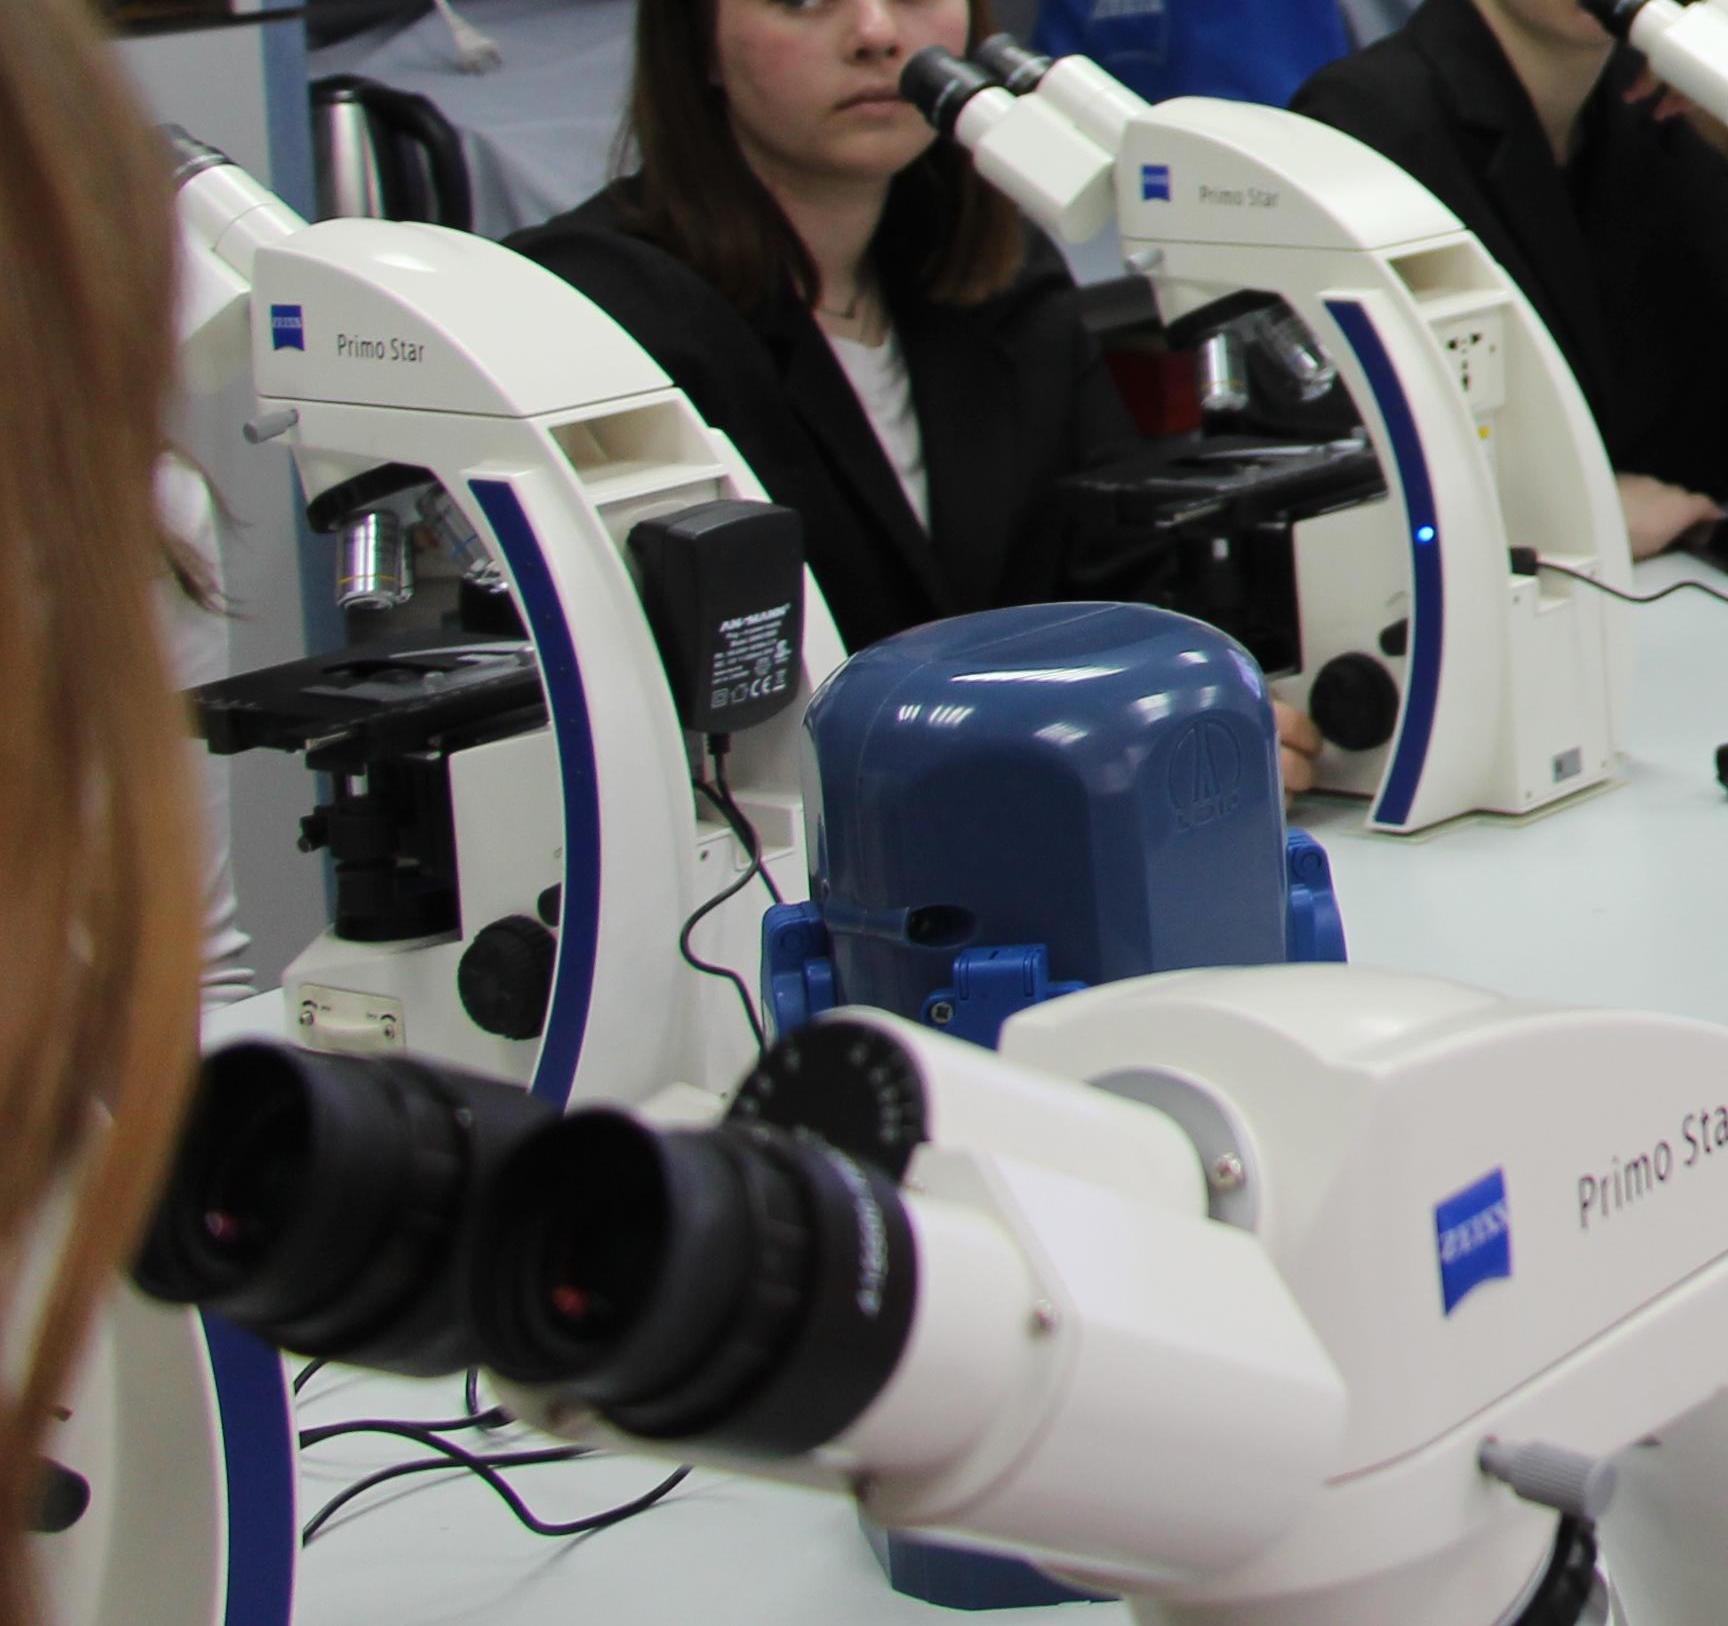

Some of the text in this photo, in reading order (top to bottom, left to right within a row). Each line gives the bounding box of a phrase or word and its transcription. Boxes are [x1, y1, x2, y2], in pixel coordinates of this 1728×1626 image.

[337, 334, 425, 362] Primo Star
[1577, 1139, 1673, 1229] Primo
